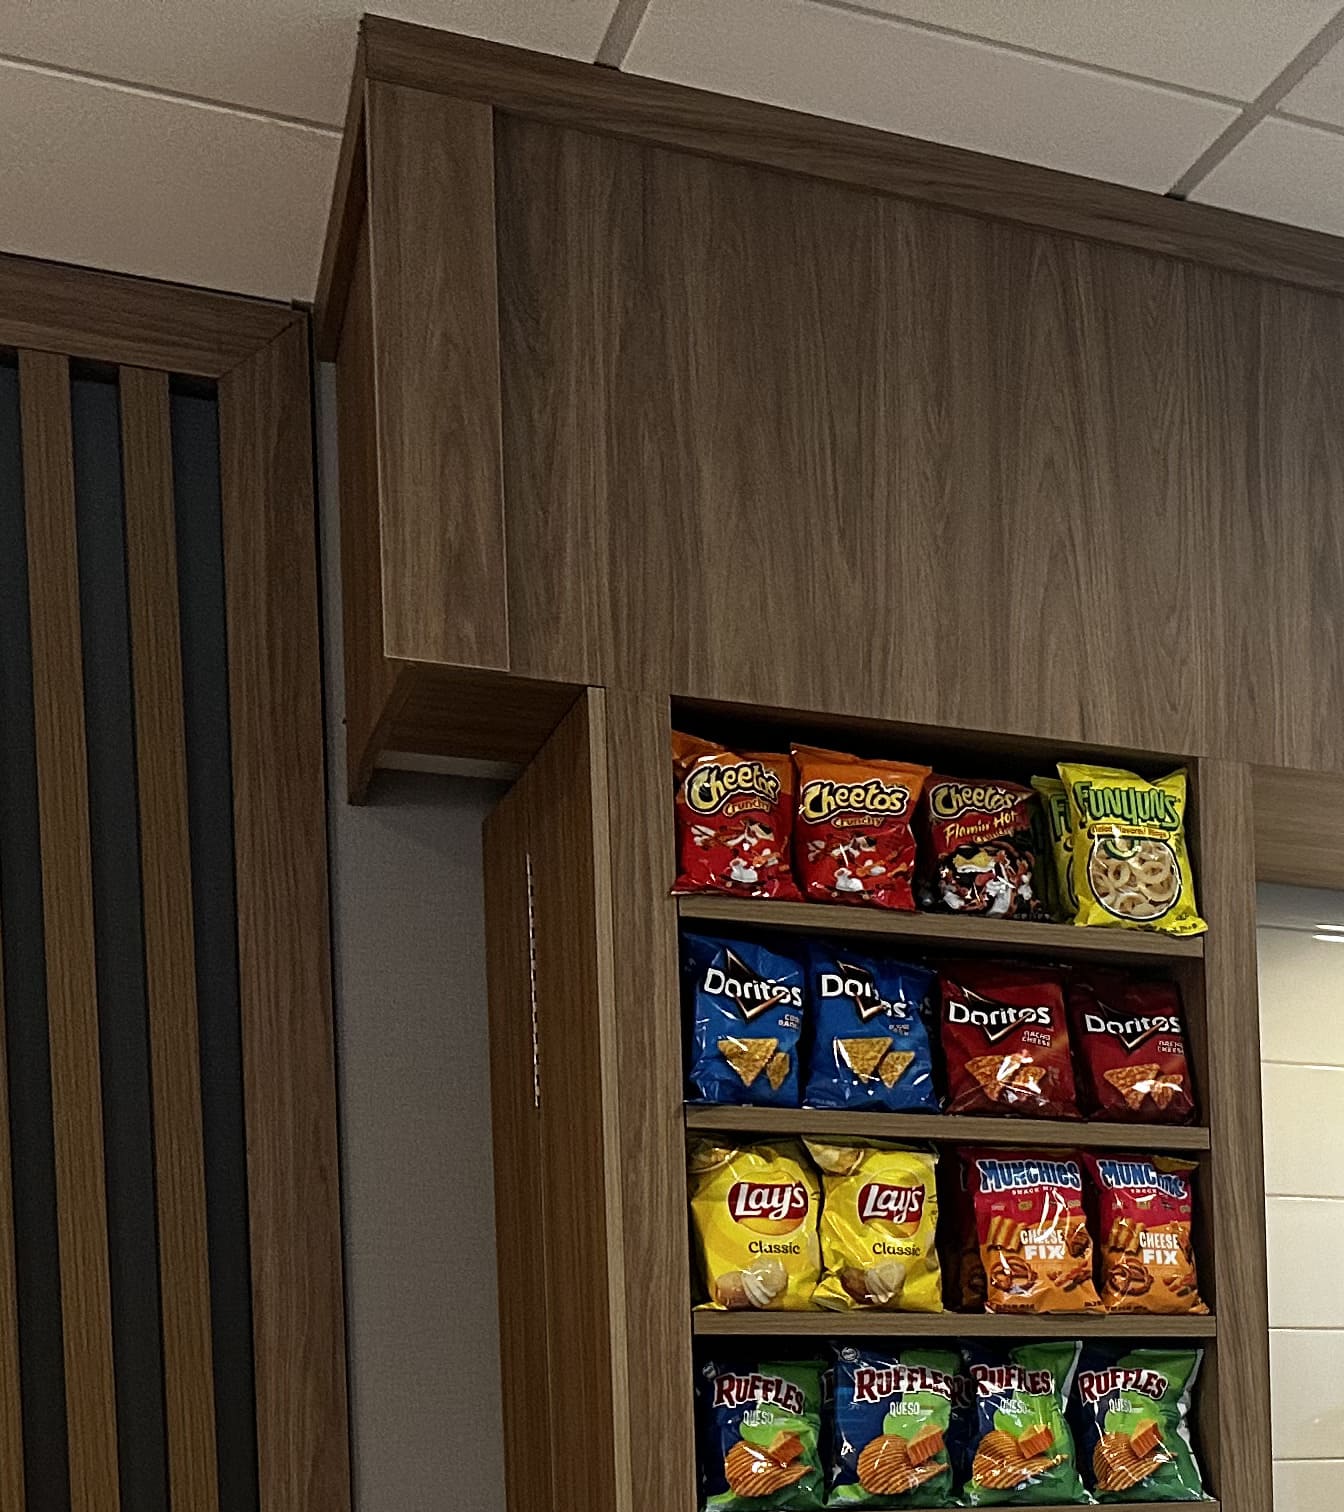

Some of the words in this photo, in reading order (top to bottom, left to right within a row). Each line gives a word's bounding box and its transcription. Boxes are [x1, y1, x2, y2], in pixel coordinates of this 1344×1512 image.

[687, 763, 780, 812] Cheetos
[802, 780, 909, 820] Cheetos
[933, 785, 1016, 816] Cheetos
[993, 810, 1019, 829] Hot
[1073, 780, 1181, 831] FUNYUNS
[704, 967, 801, 1006] Doritos
[949, 1001, 1051, 1026] Doritos
[1084, 1014, 1181, 1034] Doritos
[977, 1159, 1082, 1192] MUNCHIES
[735, 1183, 805, 1221] Lay's
[863, 1184, 922, 1225] Lay's
[748, 1241, 801, 1255] Classic
[872, 1242, 921, 1256] Classic
[1024, 1246, 1066, 1261] FIX
[1139, 1231, 1180, 1249] CHEESE
[1143, 1250, 1178, 1265] FIX
[713, 1373, 805, 1415] RUFFLES
[854, 1365, 953, 1403] RUFFLES
[970, 1365, 1053, 1397] RUFFLES
[1079, 1367, 1168, 1405] RUFFLES
[743, 1410, 775, 1426] QUESO
[889, 1401, 920, 1417] QUESO
